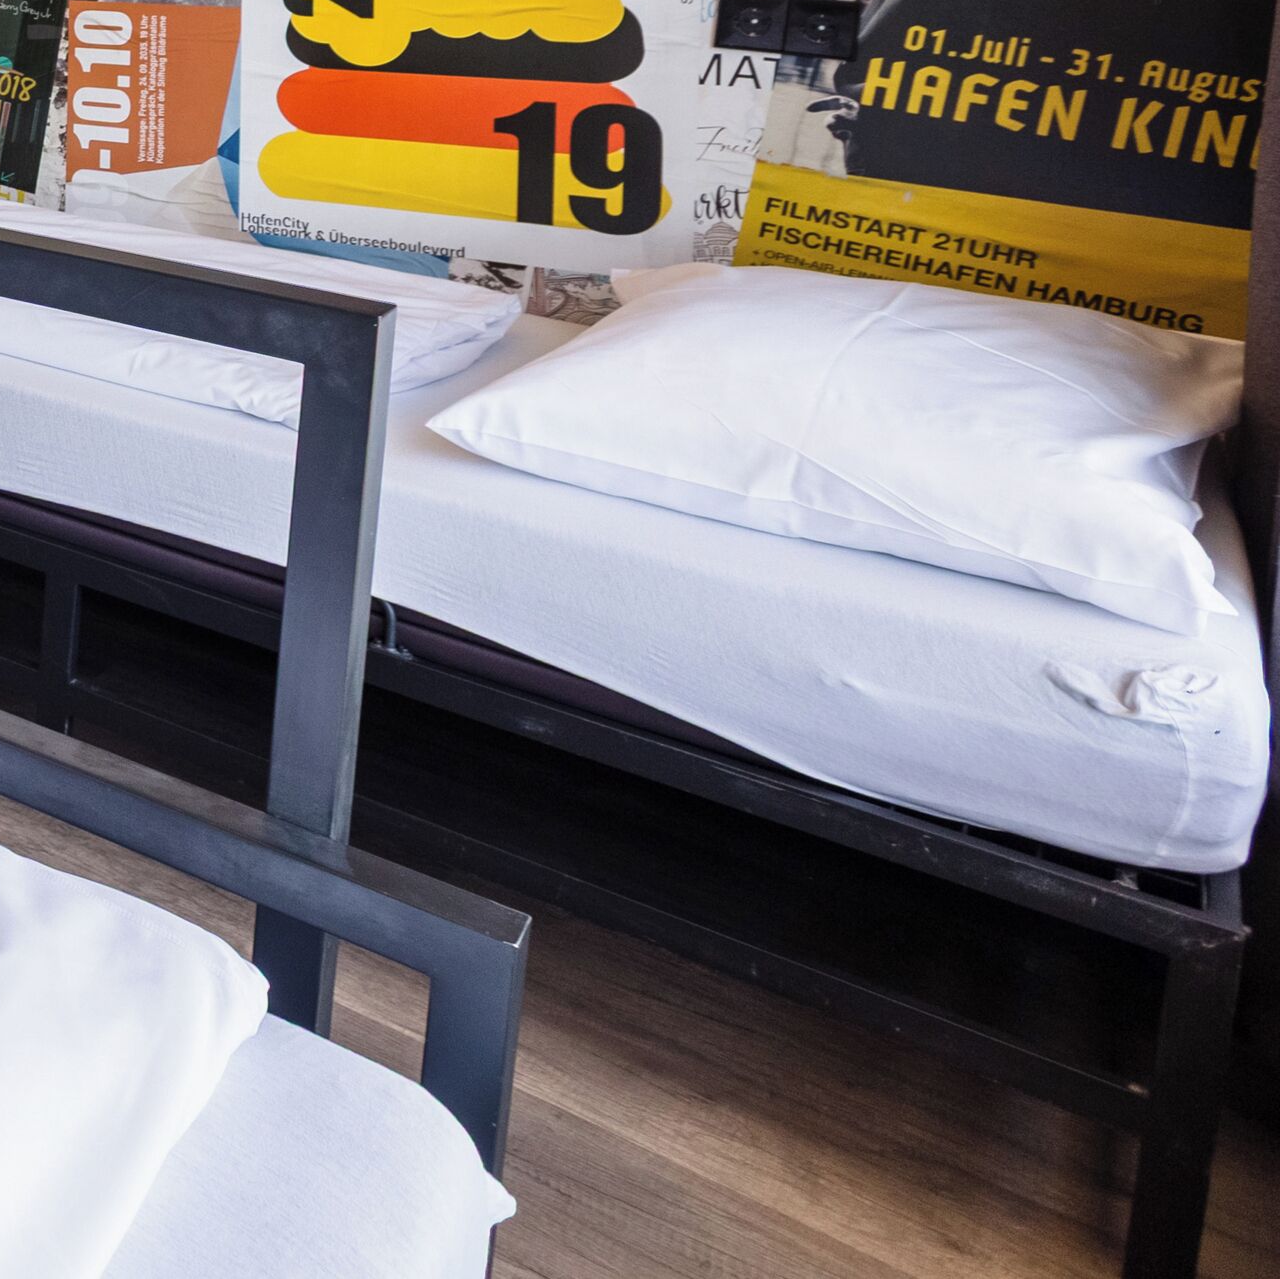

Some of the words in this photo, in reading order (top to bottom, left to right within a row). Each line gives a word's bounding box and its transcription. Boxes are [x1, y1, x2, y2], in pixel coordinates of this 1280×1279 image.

[860, 57, 1088, 141] HAFEN
[1110, 97, 1260, 170] KIN
[1140, 60, 1267, 104] Augus
[494, 102, 663, 235] 19
[765, 198, 926, 244] FILMSTART
[759, 222, 1017, 293] FISCHEREIHAFEN
[1027, 280, 1205, 334] HAMBURG
